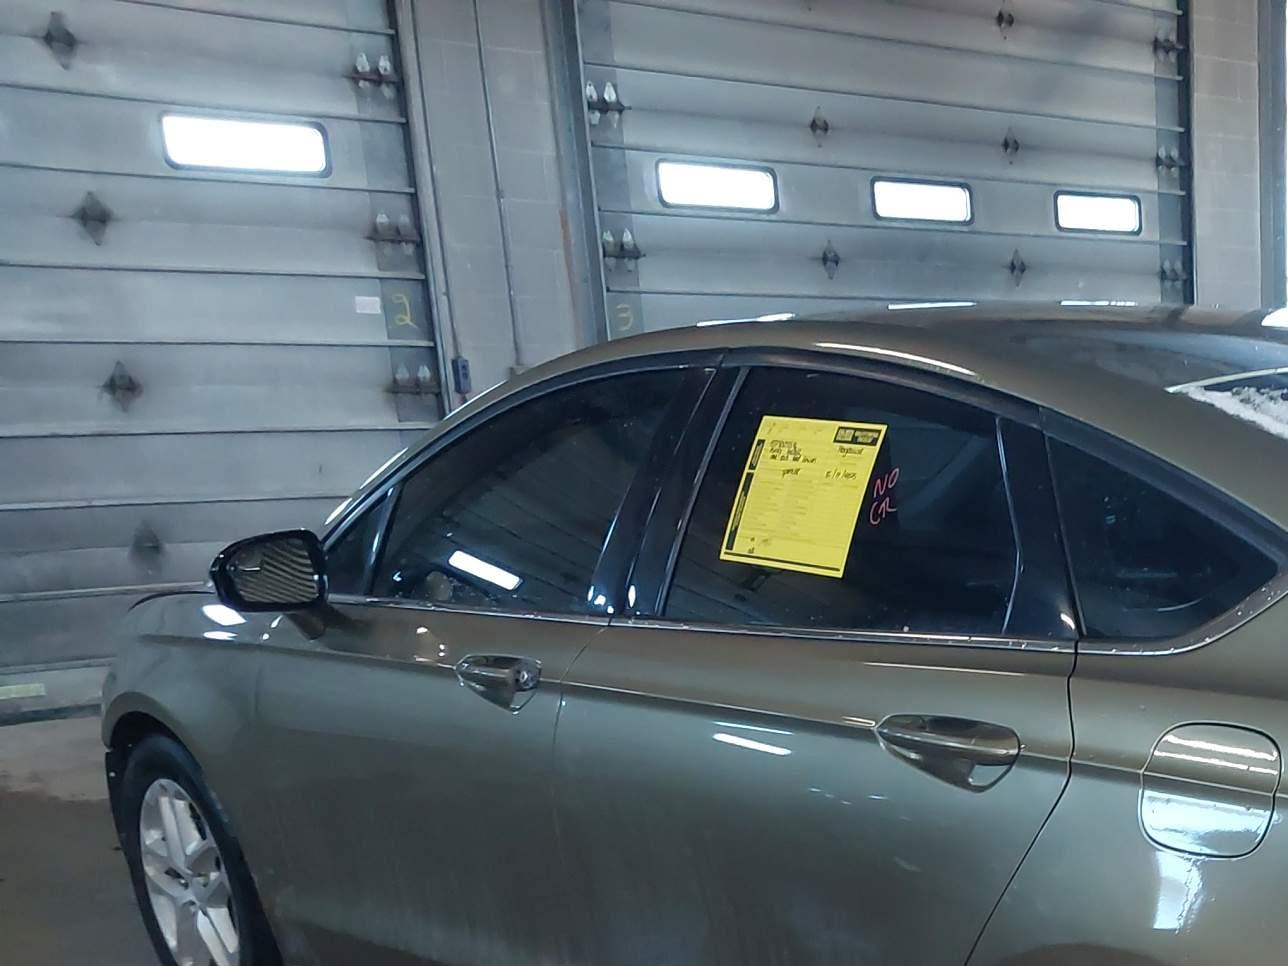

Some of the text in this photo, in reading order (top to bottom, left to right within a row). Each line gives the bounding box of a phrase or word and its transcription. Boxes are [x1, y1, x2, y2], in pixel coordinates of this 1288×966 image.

[391, 293, 418, 329] 2
[615, 303, 634, 331] 3
[873, 467, 900, 498] NO
